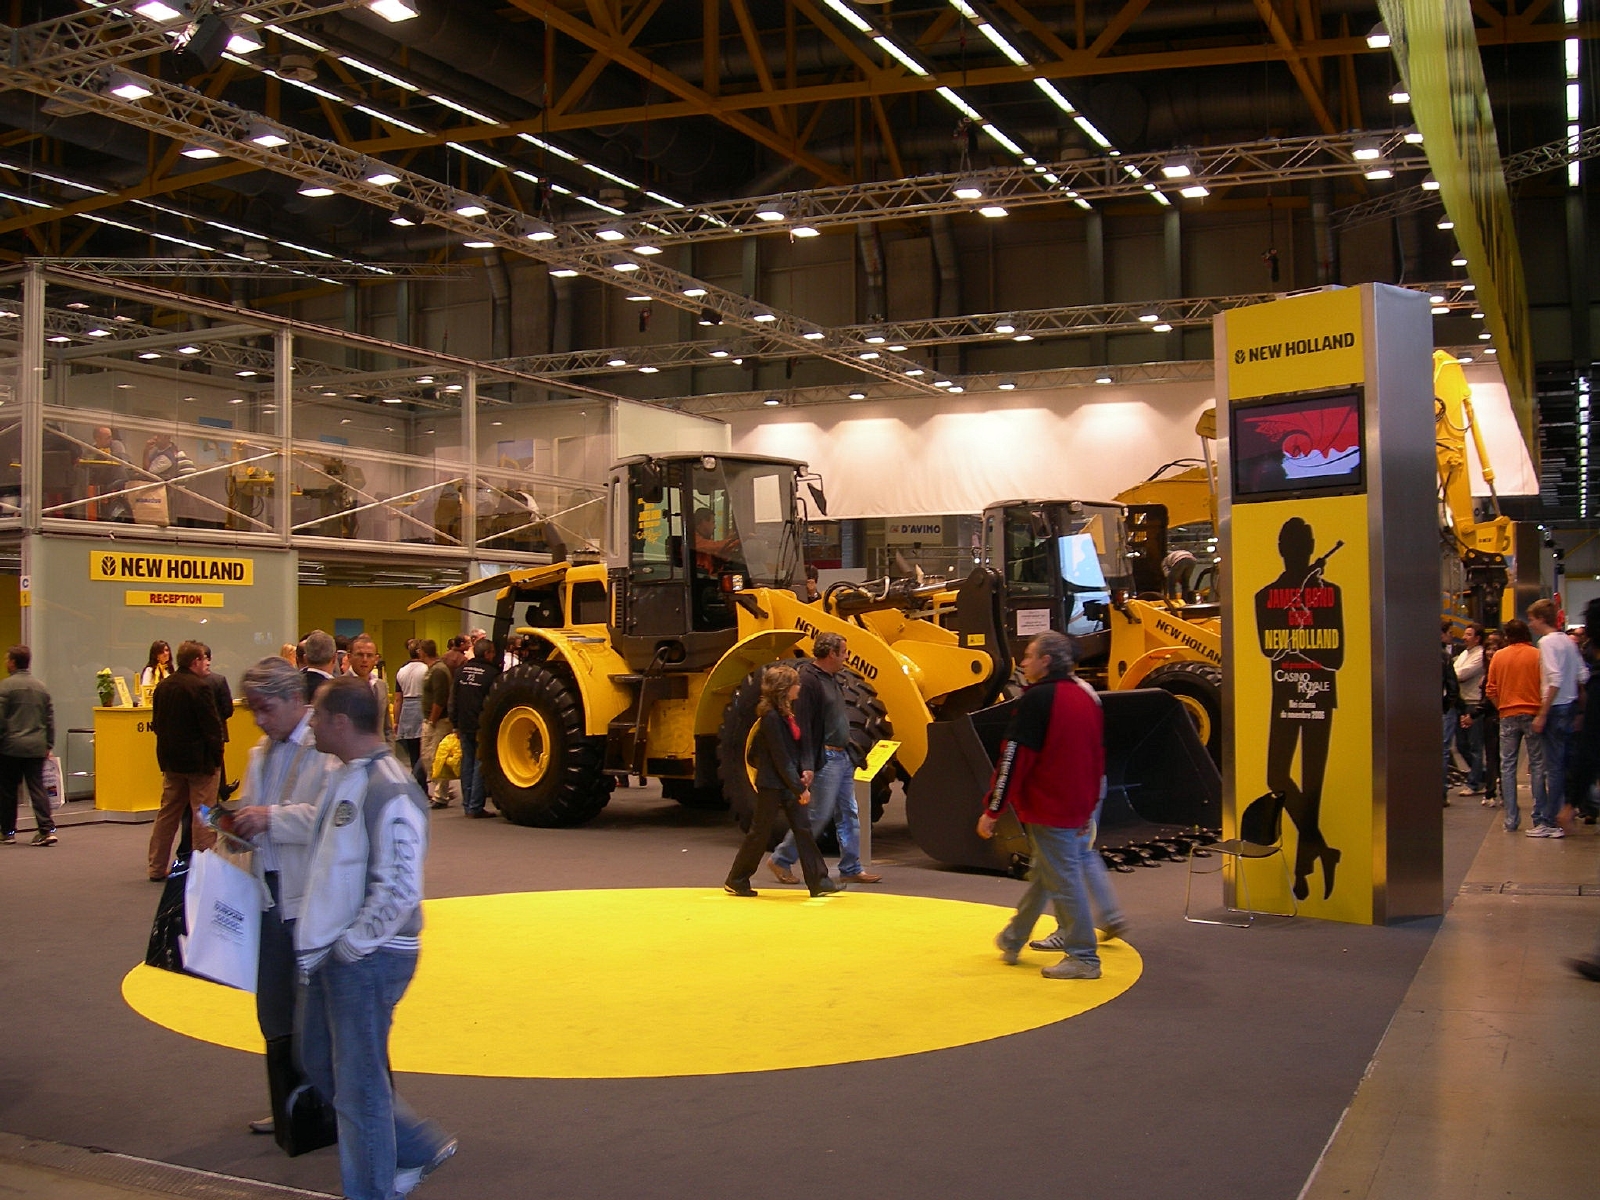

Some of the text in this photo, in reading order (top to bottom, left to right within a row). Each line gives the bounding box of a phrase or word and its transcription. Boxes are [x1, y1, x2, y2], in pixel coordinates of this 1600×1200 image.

[1248, 332, 1355, 362] NEW HOLLAND
[121, 557, 244, 581] NEW HOLLAND
[149, 593, 202, 605] RECEPTION
[1266, 587, 1334, 609] JAMES BOND
[1156, 619, 1223, 664] NEW HOLLAN
[1265, 629, 1339, 649] NEW HOLLAND
[1297, 681, 1331, 693] ROYALE
